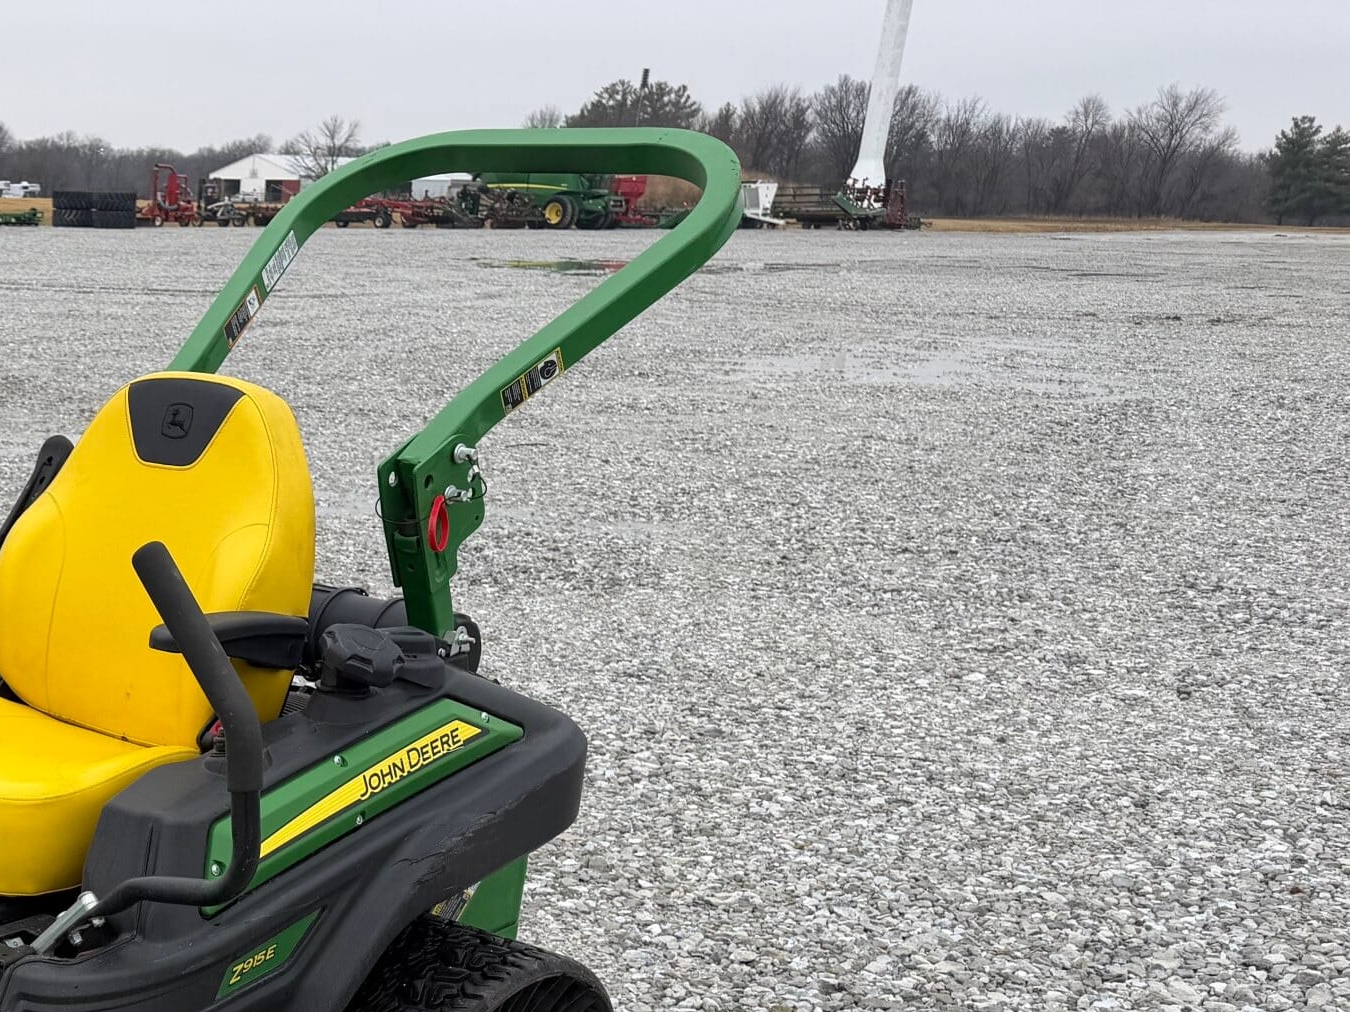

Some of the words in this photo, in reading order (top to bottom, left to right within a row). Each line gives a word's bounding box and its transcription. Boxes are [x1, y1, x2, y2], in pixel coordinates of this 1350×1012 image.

[360, 758, 406, 798] JOHN
[406, 727, 462, 769] DEERE
[230, 944, 277, 985] Z915E
